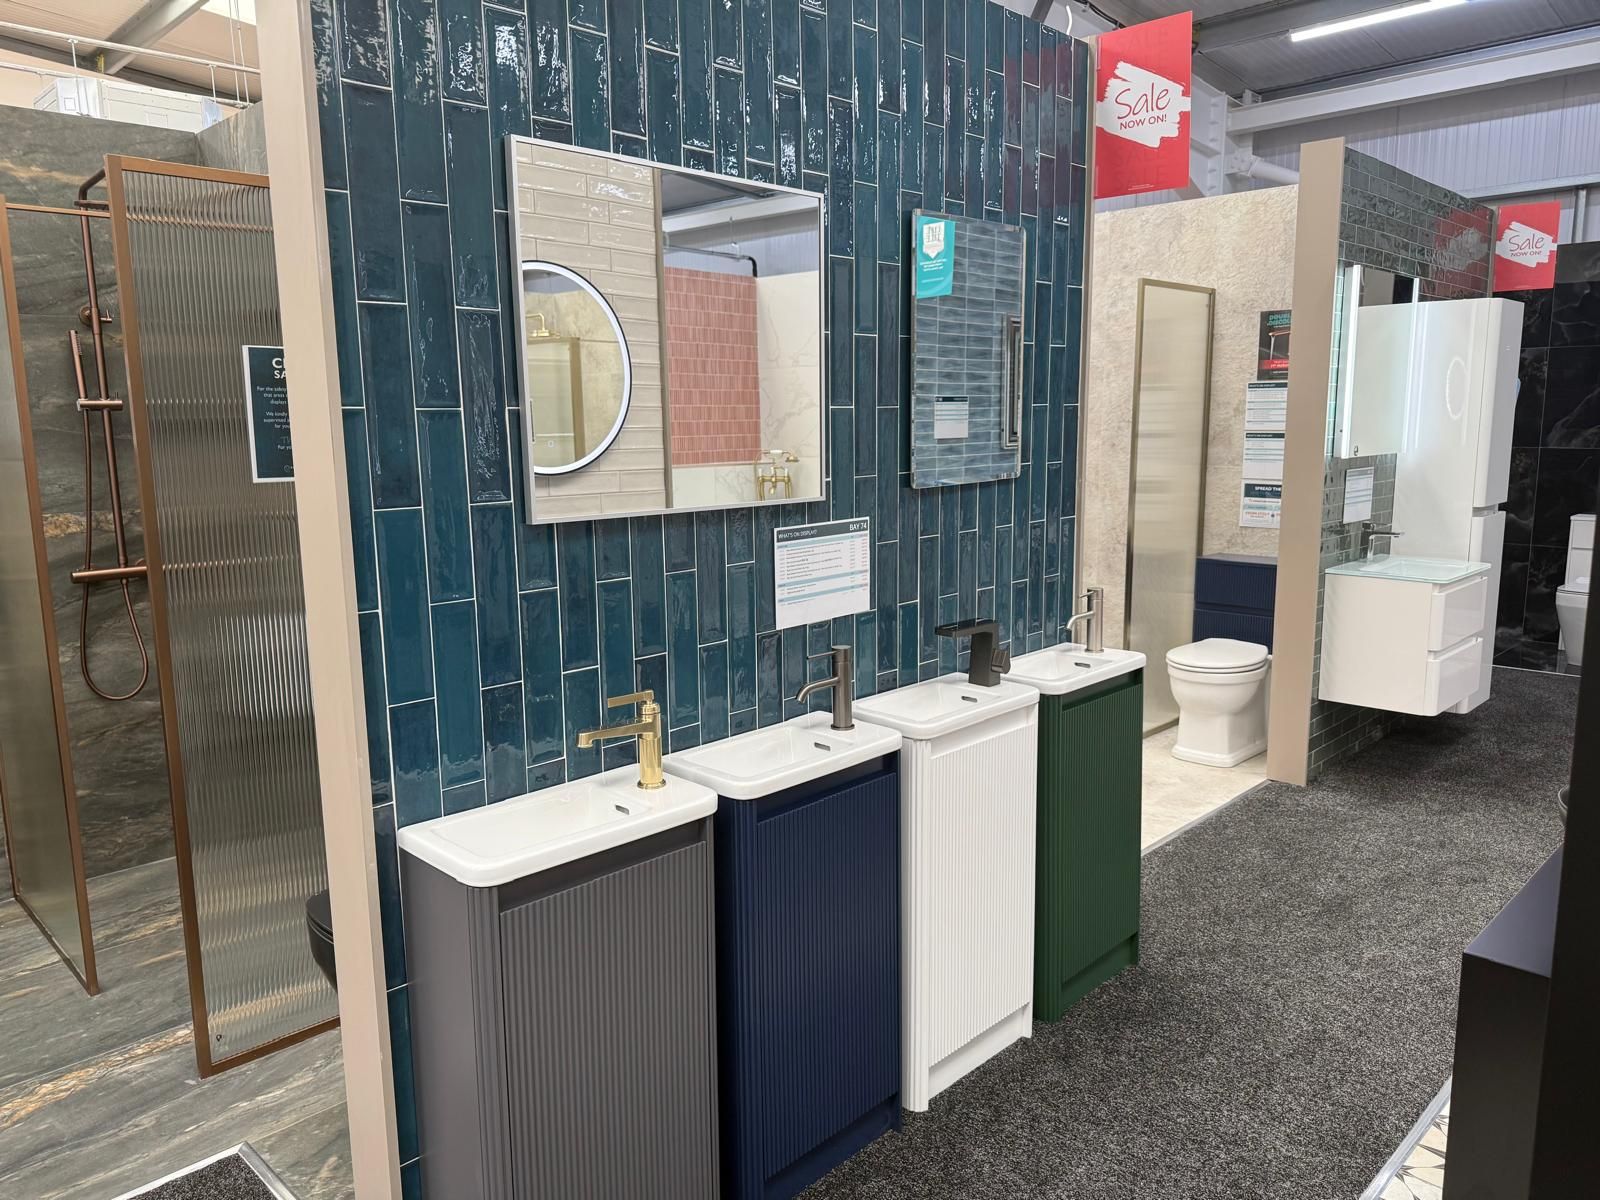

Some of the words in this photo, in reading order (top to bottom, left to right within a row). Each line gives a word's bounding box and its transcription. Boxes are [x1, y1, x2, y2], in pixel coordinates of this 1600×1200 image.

[1115, 82, 1171, 120] Sale
[1119, 117, 1146, 131] NOW
[1148, 113, 1168, 125] ON!
[1508, 233, 1545, 252] Sale
[272, 357, 285, 369] C
[849, 523, 860, 531] BAY
